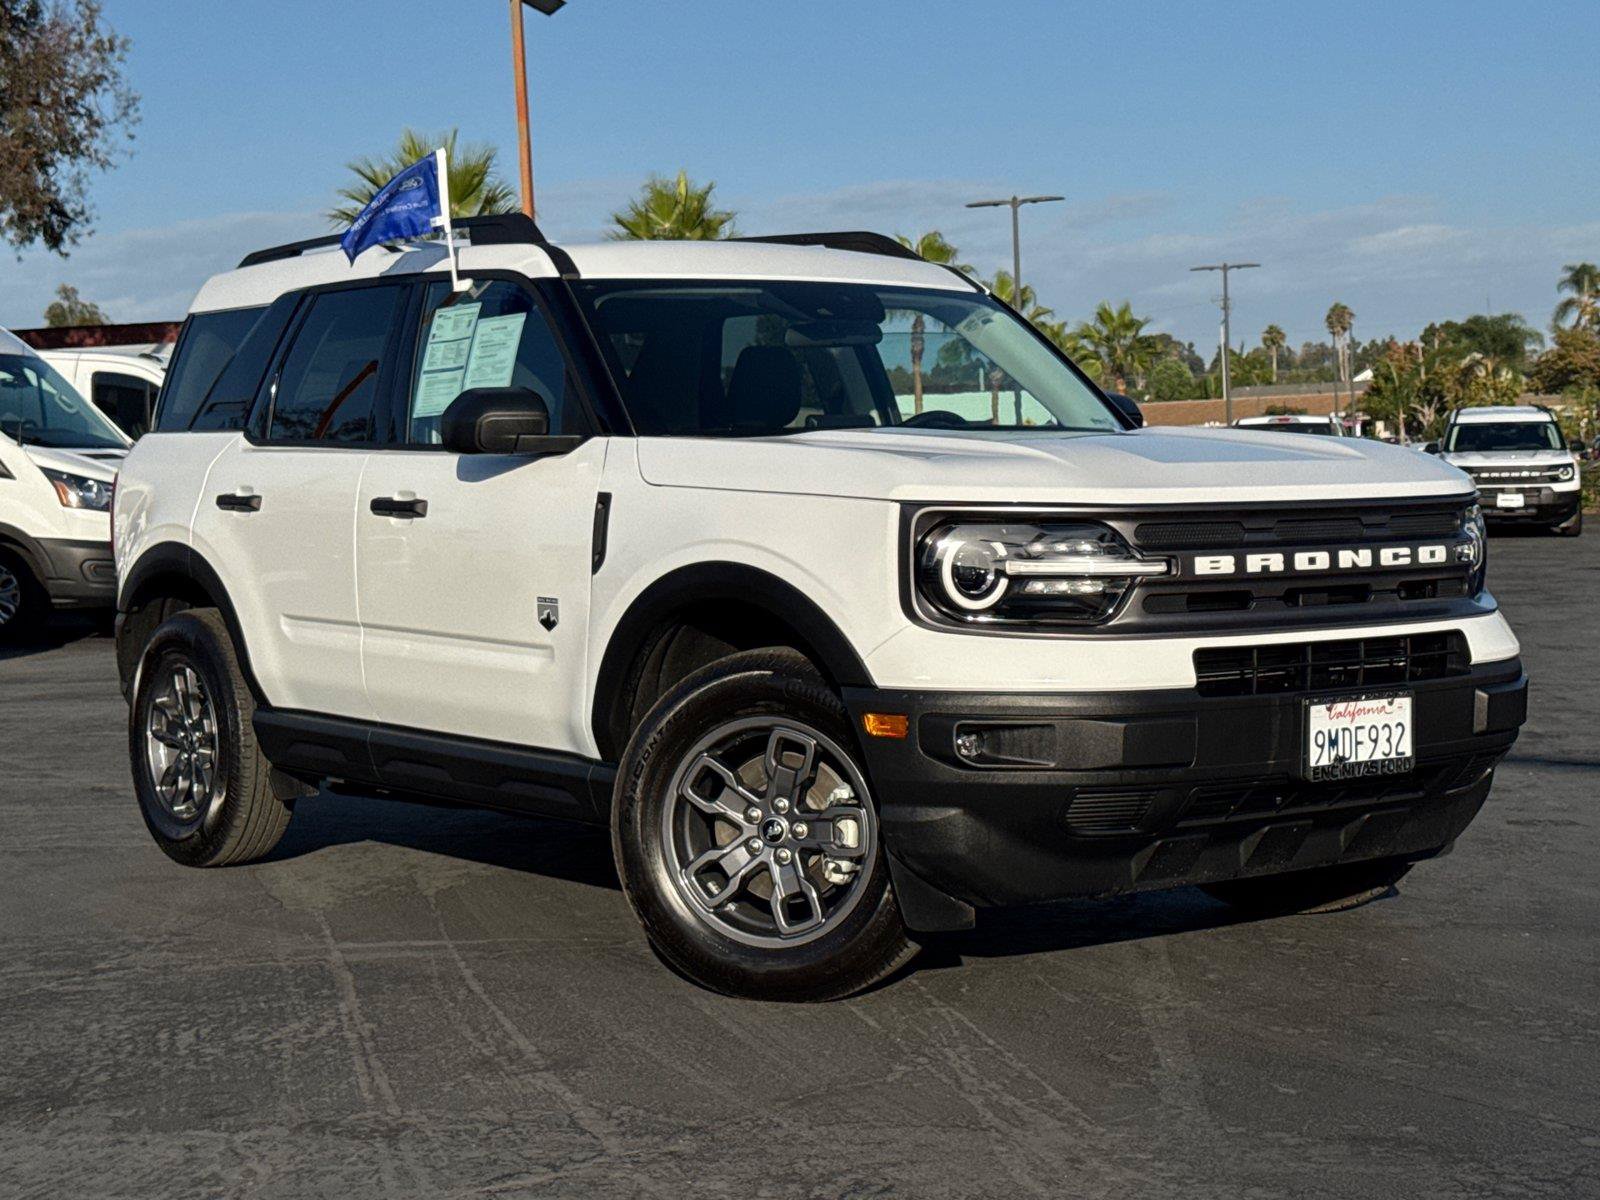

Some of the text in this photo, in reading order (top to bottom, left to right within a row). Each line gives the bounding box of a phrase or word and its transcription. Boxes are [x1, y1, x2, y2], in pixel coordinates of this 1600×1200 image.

[1194, 545, 1447, 575] BRONCO
[1328, 701, 1393, 724] California
[1314, 721, 1406, 766] 9MDF932
[1380, 757, 1412, 775] FORD
